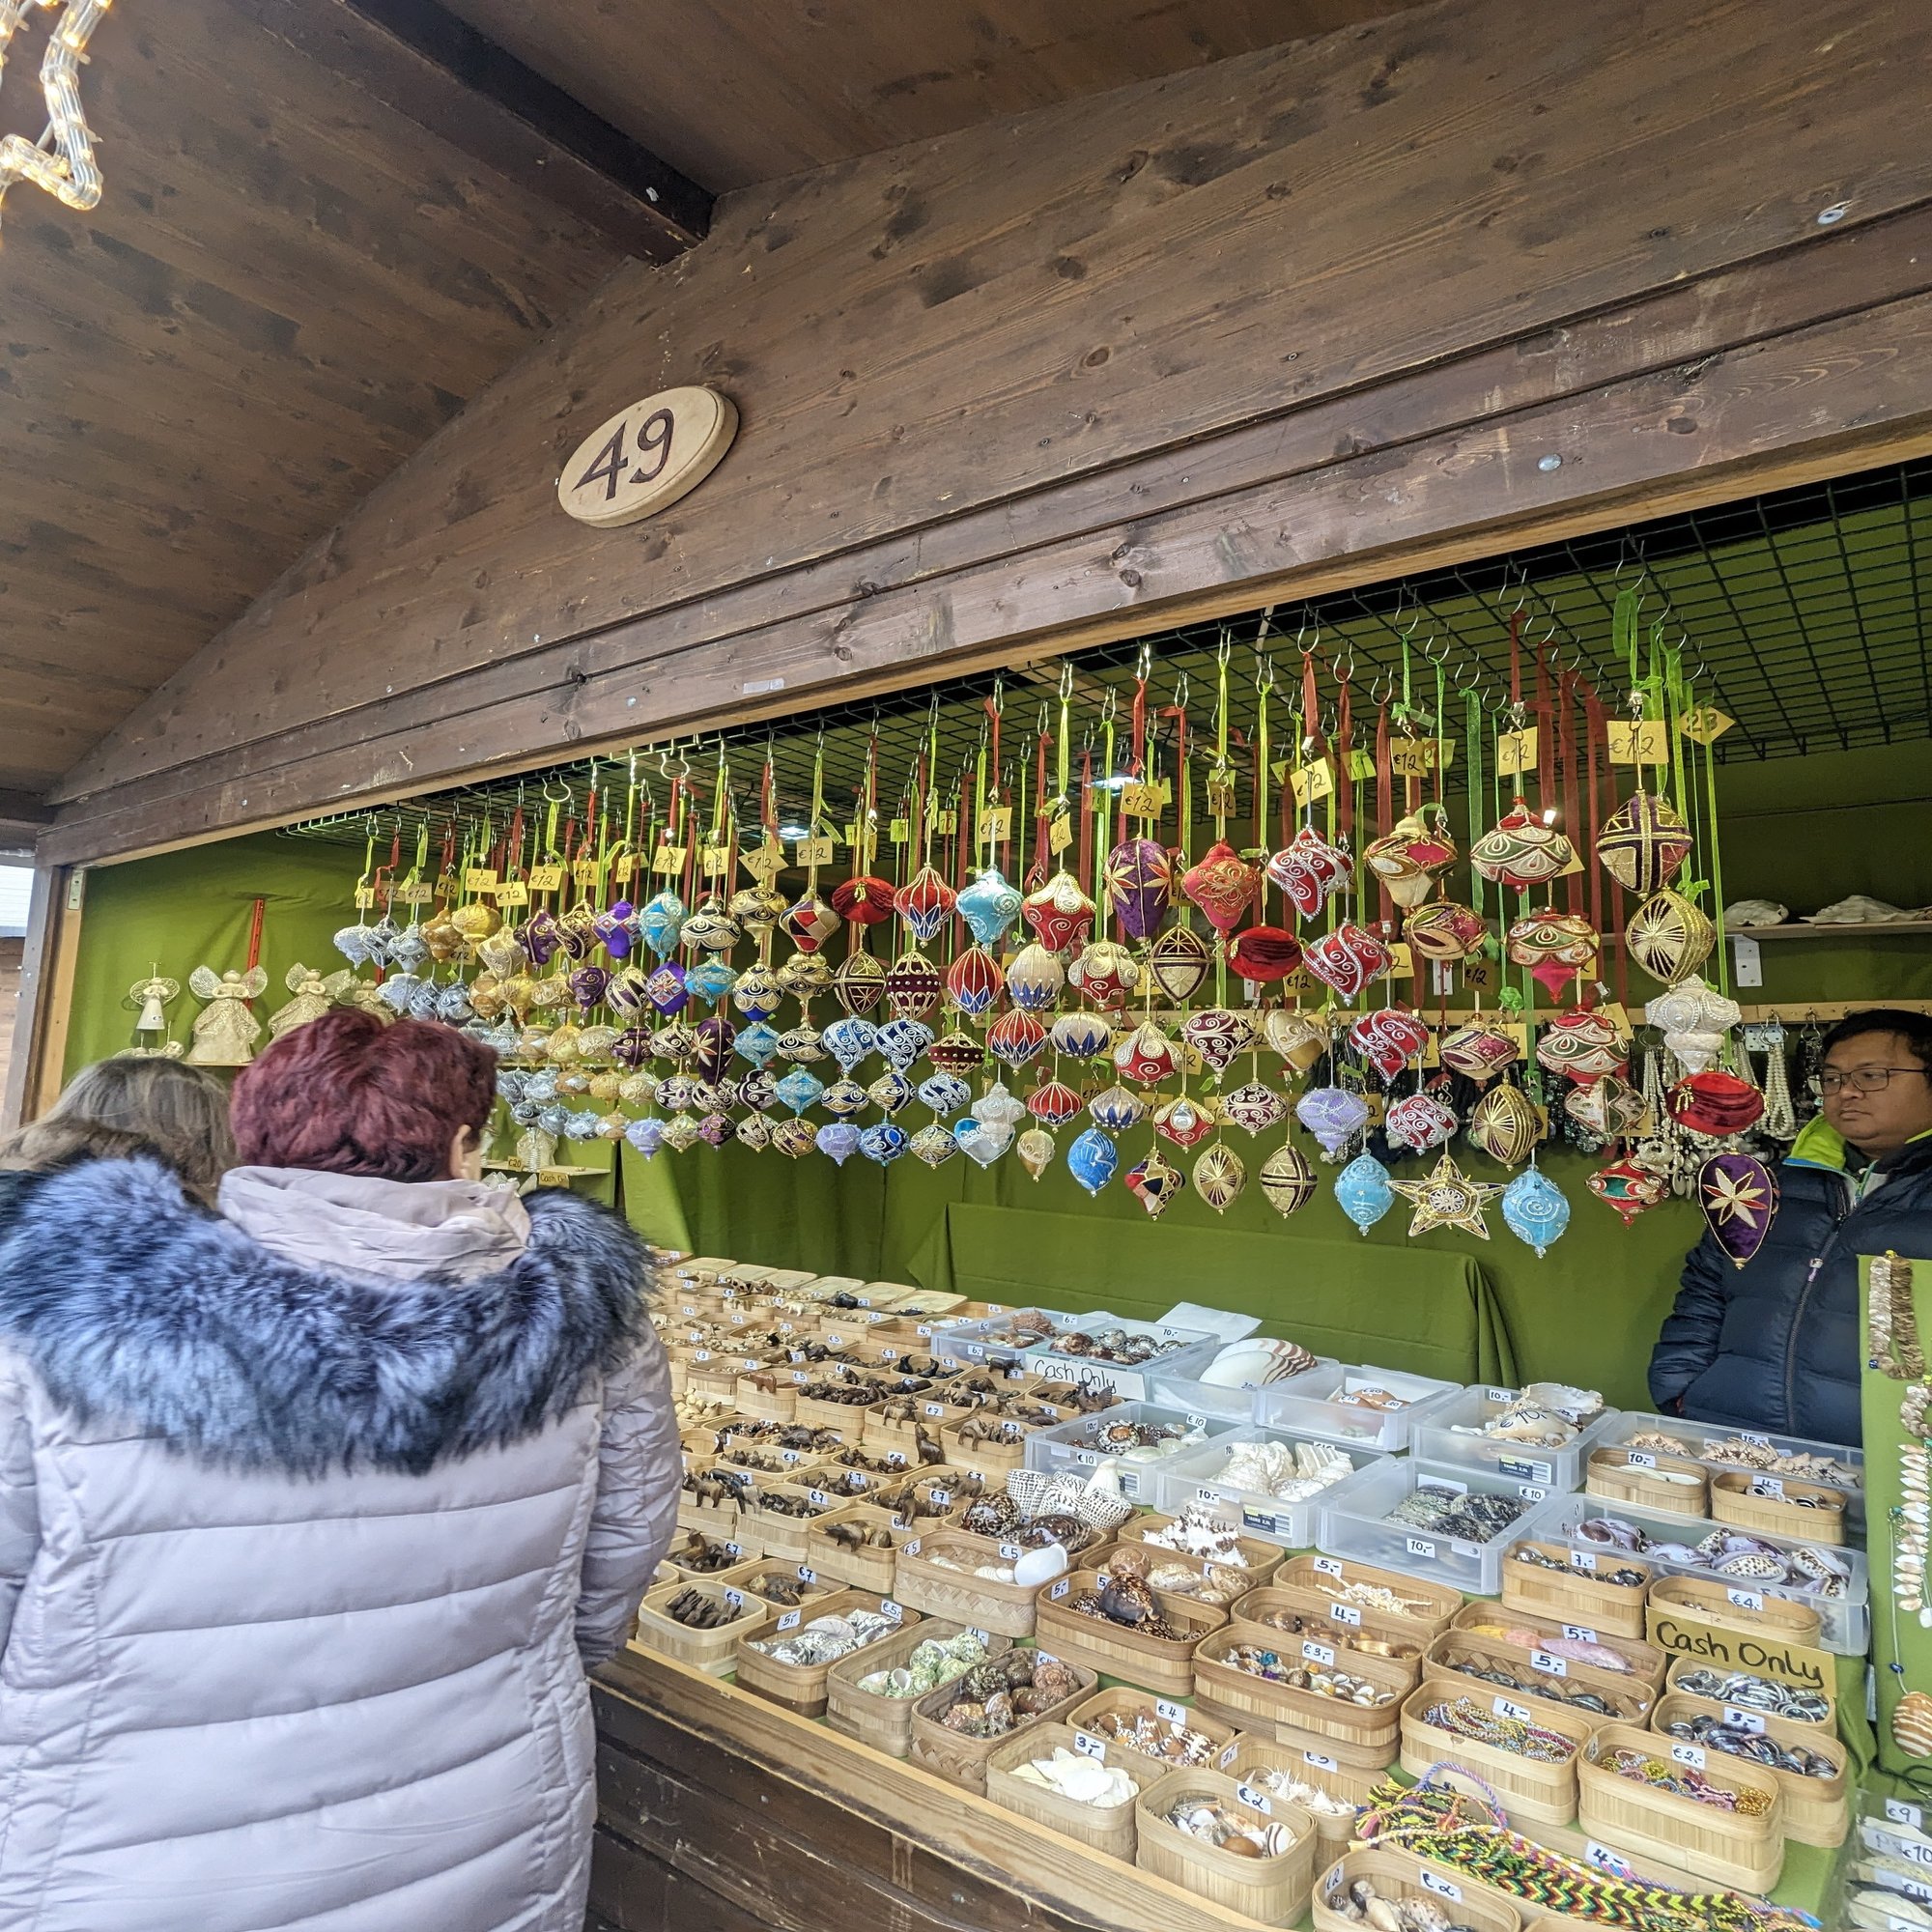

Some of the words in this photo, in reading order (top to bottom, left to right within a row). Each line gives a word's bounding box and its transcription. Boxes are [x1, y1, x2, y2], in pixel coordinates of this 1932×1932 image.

[572, 408, 674, 500] 49
[1607, 734, 1655, 756] €12
[1501, 743, 1531, 762] €12
[1393, 752, 1421, 772] €12
[1295, 772, 1326, 798] €2
[1124, 796, 1156, 812] €12
[1210, 790, 1234, 810] €12
[747, 856, 773, 869] €12
[467, 876, 491, 888] €12
[530, 873, 555, 887] €12
[408, 889, 428, 899] €12
[438, 880, 457, 895] €12
[357, 894, 372, 907] €2
[497, 890, 523, 900] €12
[1287, 974, 1312, 989] €12
[1465, 967, 1488, 985] €12
[794, 1372, 806, 1381] €5
[1034, 1358, 1074, 1382] Cash
[1081, 1367, 1117, 1395] Only
[927, 1406, 939, 1416] €7
[1004, 1422, 1017, 1432] €7
[1187, 1415, 1204, 1427] €10
[783, 1452, 797, 1462] €7
[889, 1453, 902, 1463] €7
[1077, 1453, 1094, 1464] €10
[847, 1471, 862, 1483] €7
[967, 1470, 982, 1481] €7
[811, 1491, 824, 1504] €7
[930, 1490, 945, 1503] €7
[1521, 1488, 1542, 1499] €10
[725, 1543, 739, 1554] €7
[904, 1543, 918, 1555] €5
[1001, 1546, 1019, 1559] €5
[798, 1566, 812, 1579] €7
[725, 1591, 742, 1605] €7
[1656, 1620, 1729, 1662] Cash
[1738, 1641, 1825, 1690] Only
[1158, 1704, 1178, 1719] €4
[1238, 1787, 1264, 1810] €2
[1888, 1806, 1911, 1822] €9
[1421, 1873, 1455, 1896] €2
